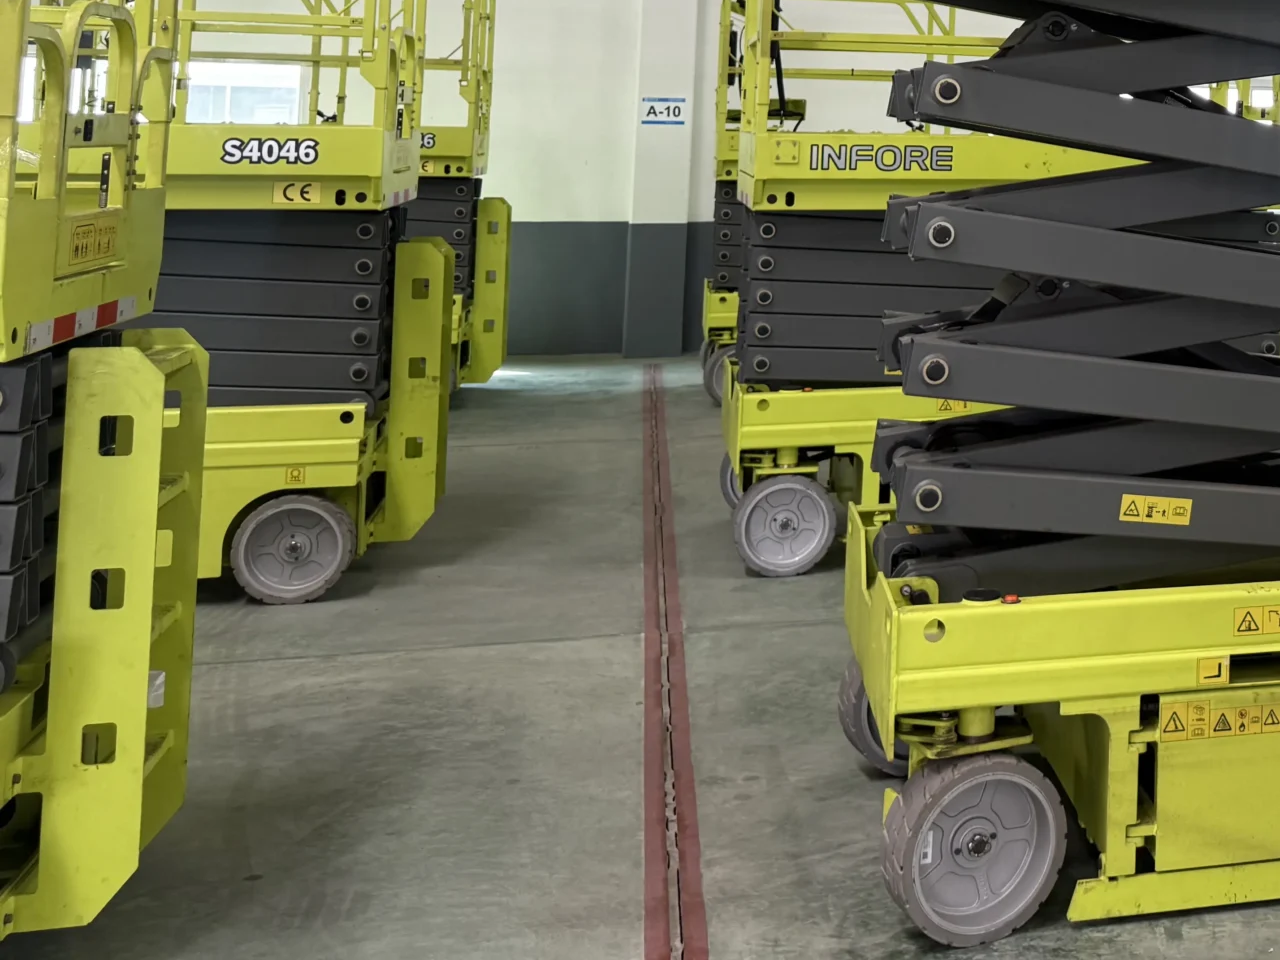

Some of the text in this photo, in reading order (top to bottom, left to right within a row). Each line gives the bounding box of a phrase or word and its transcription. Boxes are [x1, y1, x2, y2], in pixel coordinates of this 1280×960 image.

[646, 105, 682, 118] A-10
[220, 137, 320, 165] S4046
[809, 143, 954, 172] INFORE
[282, 182, 313, 202] CE
